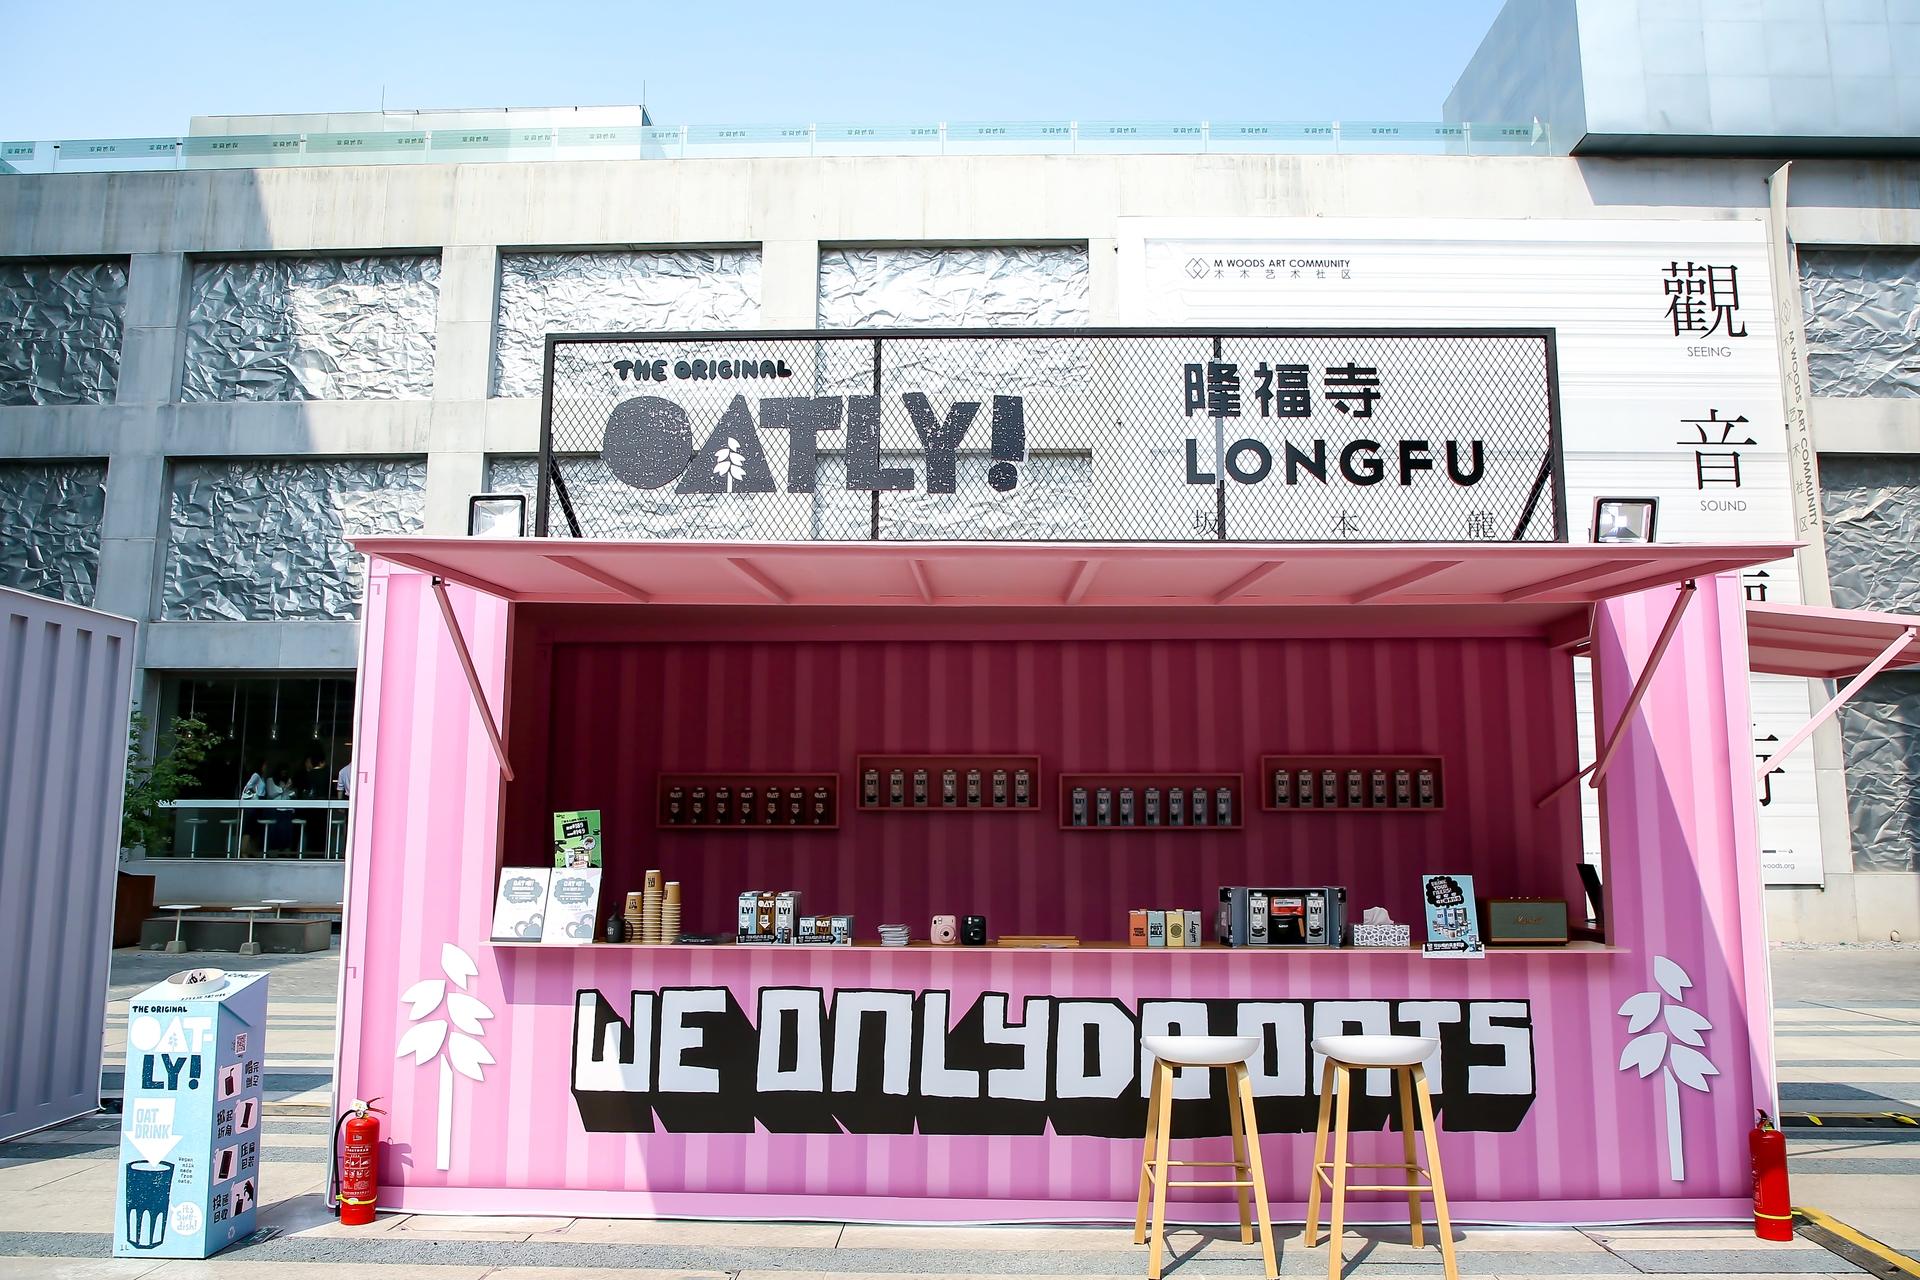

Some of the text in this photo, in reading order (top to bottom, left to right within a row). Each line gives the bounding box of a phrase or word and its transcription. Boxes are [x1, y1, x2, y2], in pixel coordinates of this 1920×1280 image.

[1214, 259, 1351, 268] M WOODS ART COMMUNITY
[1661, 261, 1748, 339] 觀
[1686, 346, 1732, 358] SEEING
[613, 359, 792, 382] THE ORIGINAL
[1790, 346, 1803, 403] WOODS
[1184, 361, 1382, 418] 隆福寺
[1797, 409, 1807, 433] ART
[601, 392, 1027, 494] OATLY!
[1677, 409, 1757, 490] 音
[1185, 438, 1486, 487] LONGFU
[1800, 437, 1819, 527] COMMUNITY
[1700, 500, 1747, 512] SOUND
[779, 907, 791, 915] LY!
[132, 1005, 188, 1014] THE ORIGINAL
[574, 987, 727, 1095] WE
[756, 988, 1049, 1101] ONLY
[141, 1054, 202, 1091] LY!
[136, 1107, 160, 1124] OAT
[134, 1124, 171, 1140] DRINK
